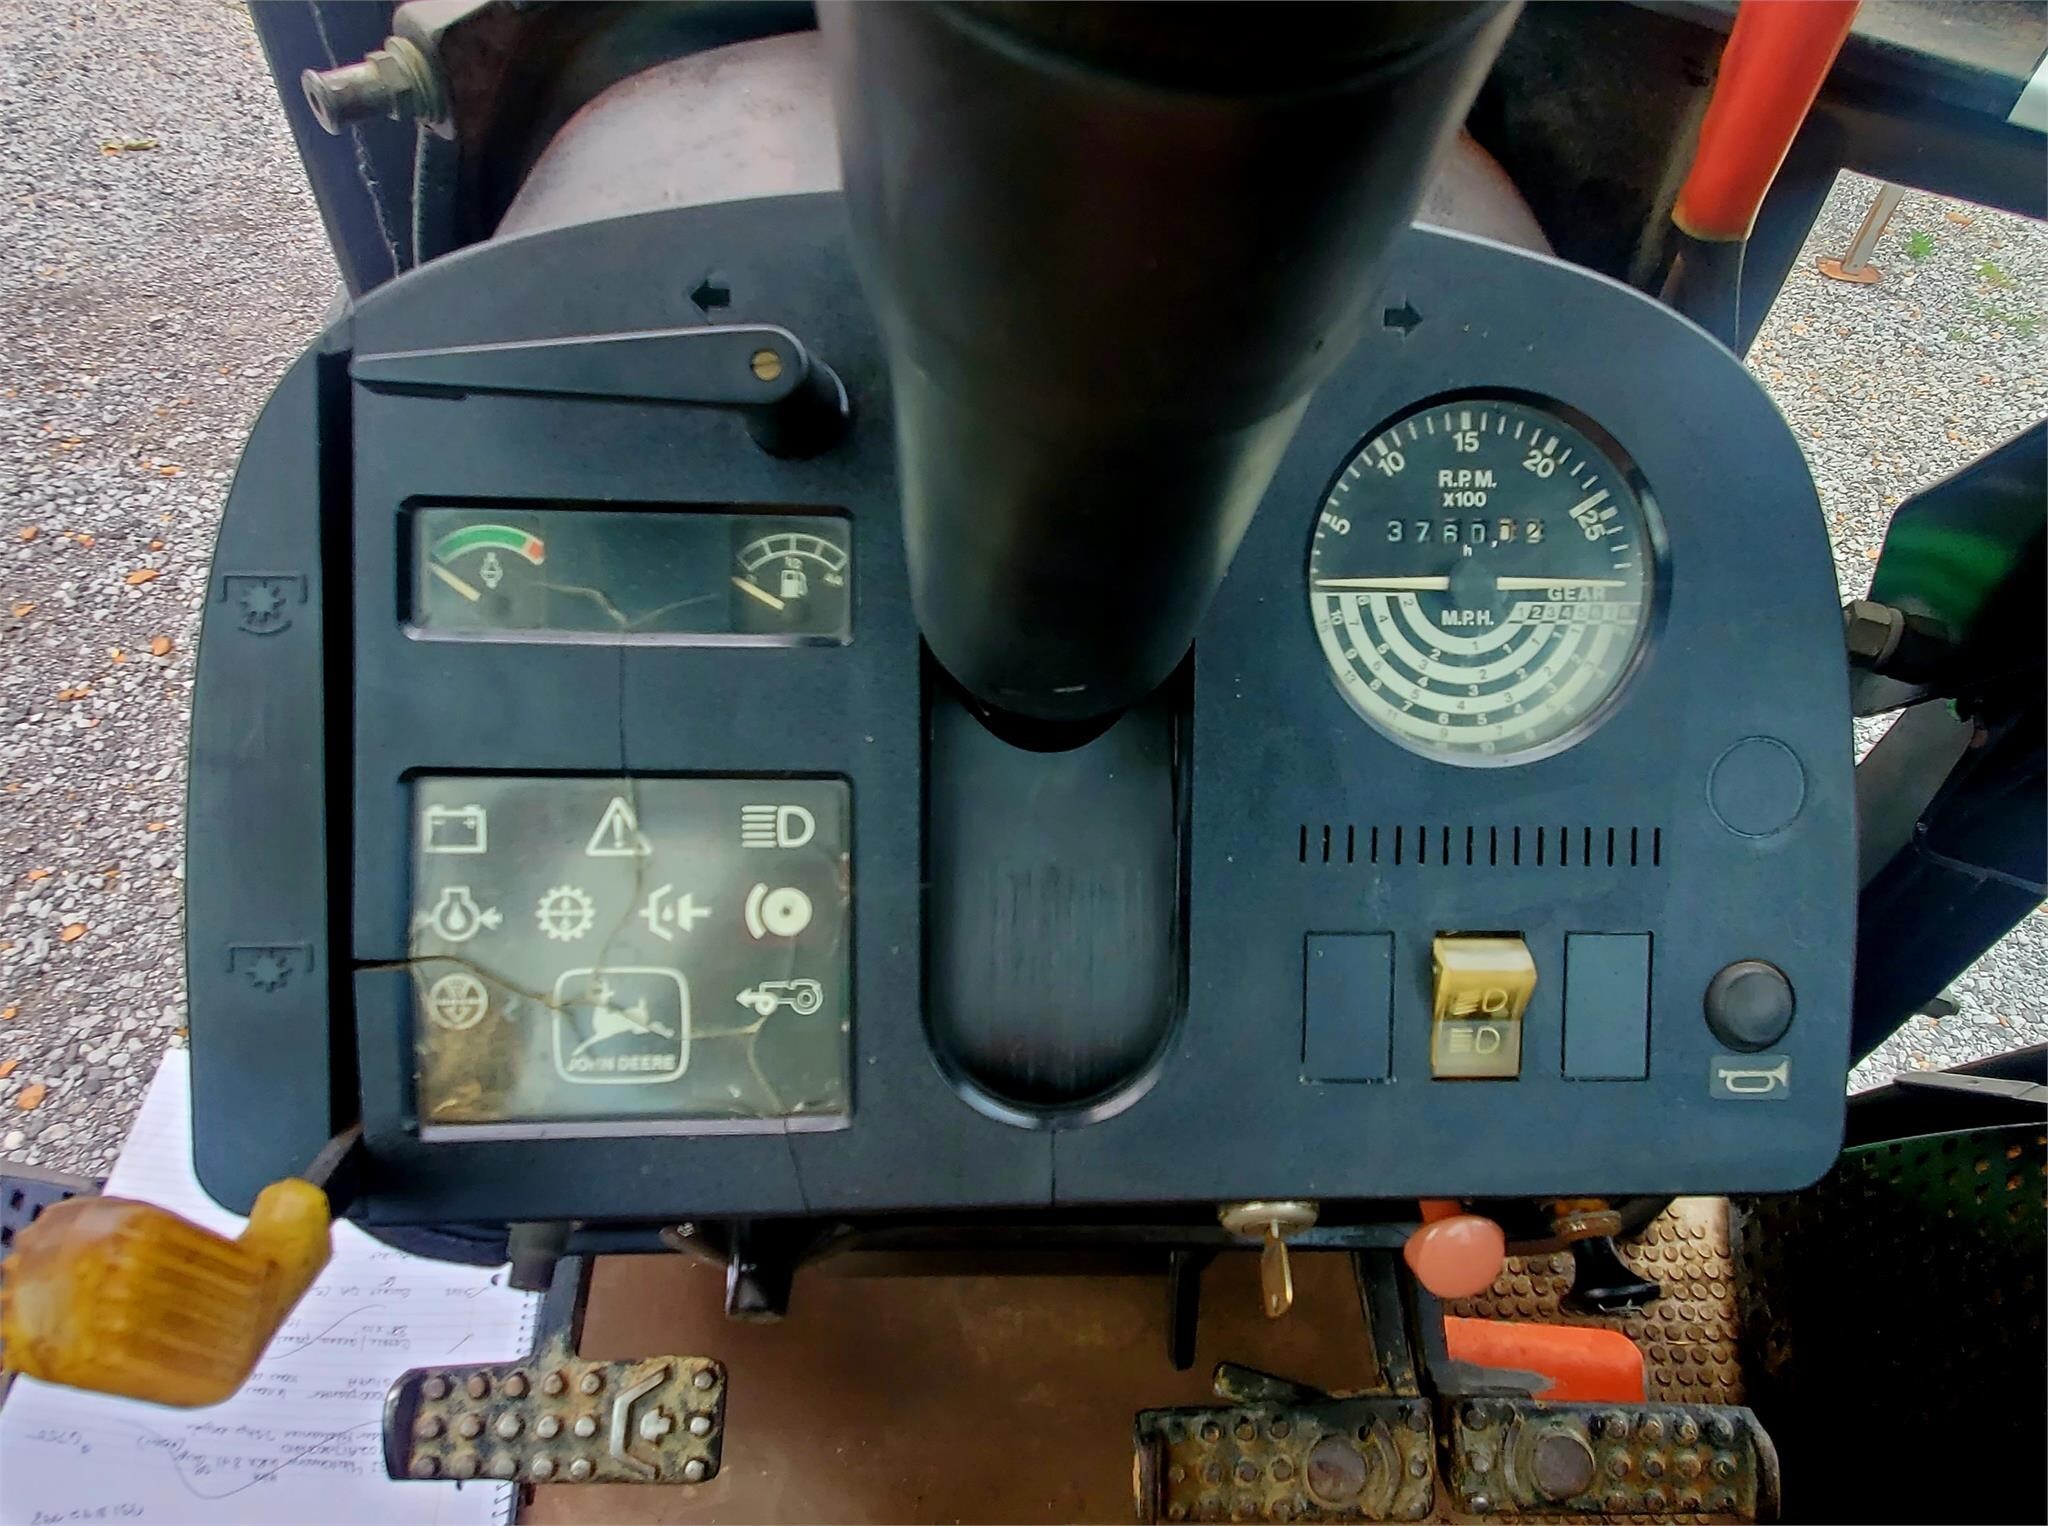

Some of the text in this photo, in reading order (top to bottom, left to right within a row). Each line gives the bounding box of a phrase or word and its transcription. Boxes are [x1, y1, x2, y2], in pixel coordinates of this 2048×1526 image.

[1452, 431, 1480, 452] 15
[1377, 451, 1405, 477] 10
[1522, 449, 1555, 479] 20
[1329, 515, 1351, 535] 5
[1547, 587, 1605, 602] GEAR
[617, 1054, 675, 1071] DEERE
